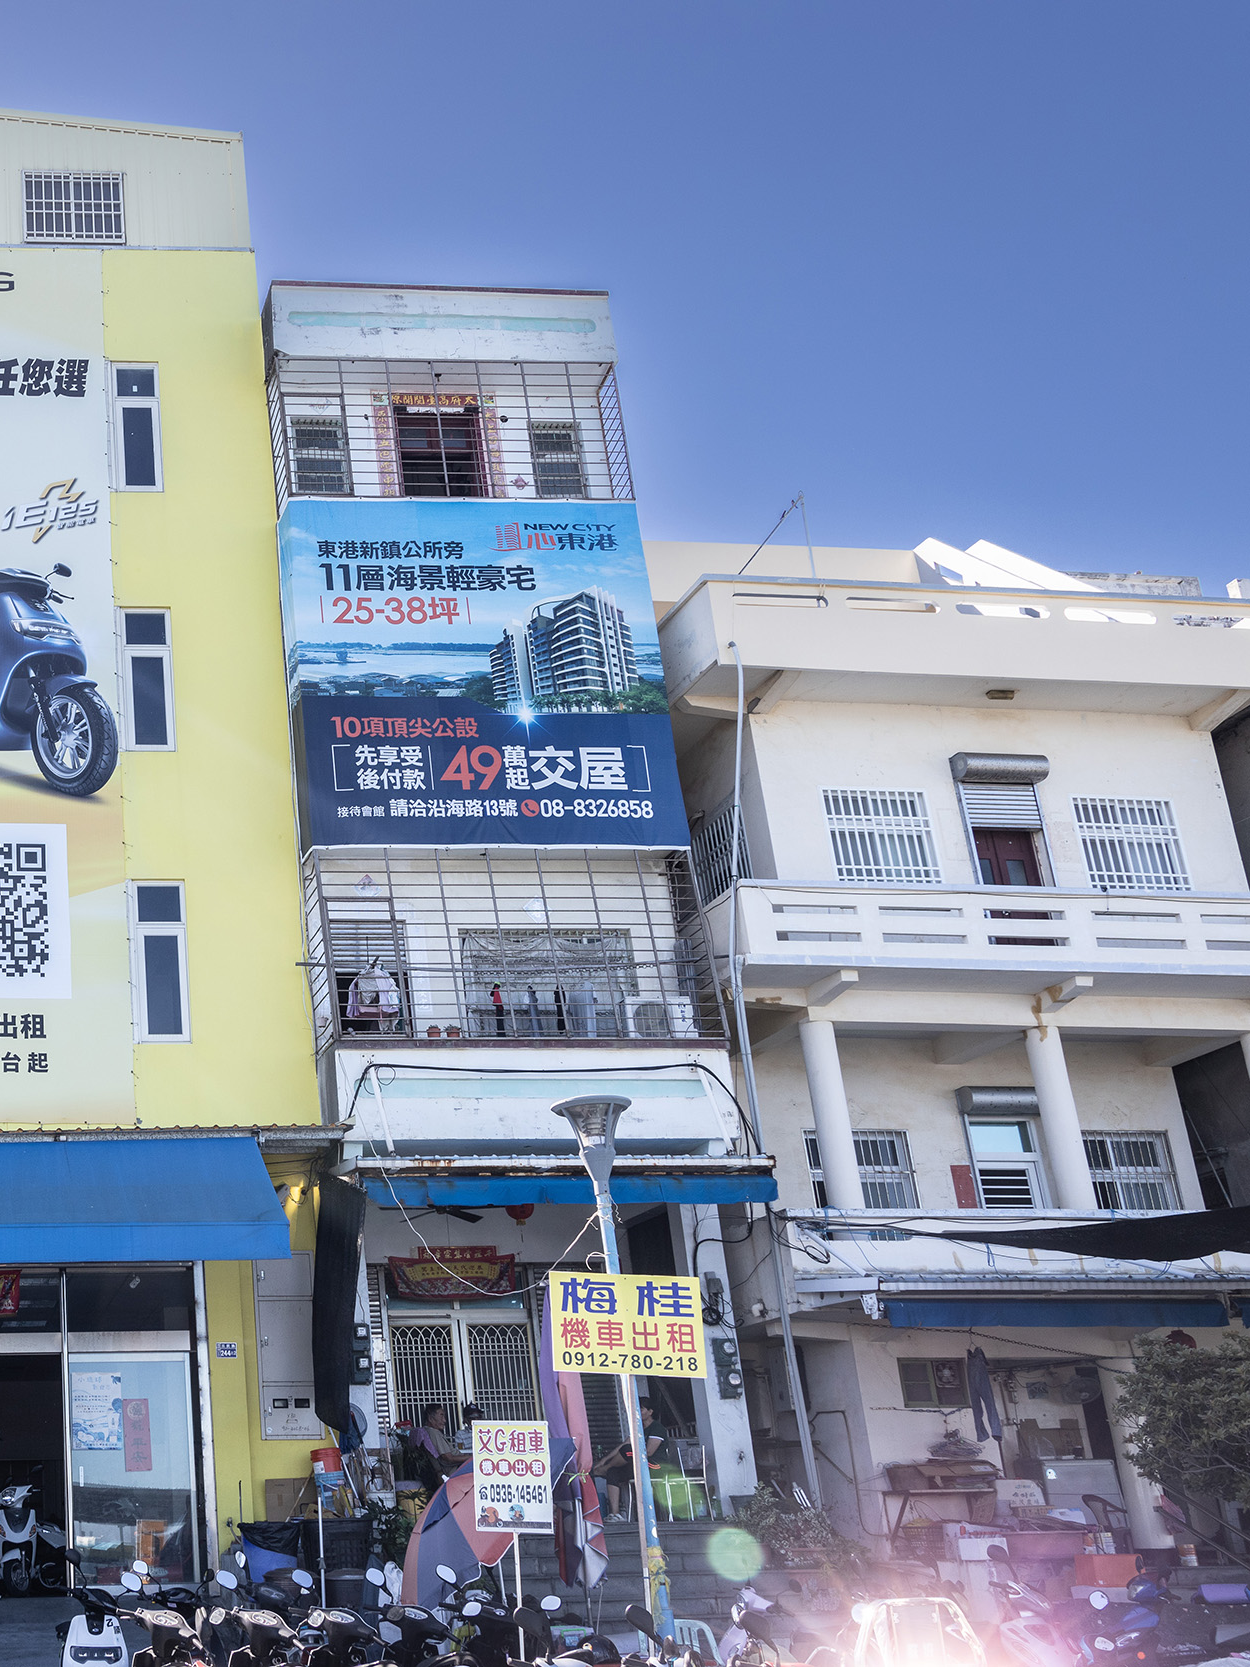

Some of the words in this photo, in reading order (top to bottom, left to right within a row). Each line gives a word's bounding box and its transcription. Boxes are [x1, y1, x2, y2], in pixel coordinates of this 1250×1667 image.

[524, 523, 569, 531] NEW
[317, 540, 464, 560] 東港新鎮公所旁
[319, 563, 537, 592] 11層海景輕豪宅
[332, 596, 460, 625] 25-38坪
[330, 716, 480, 739] 10項頂尖公設
[355, 744, 424, 767] 先享受
[356, 768, 426, 791] 後付款
[337, 806, 385, 818] 接待會館
[389, 799, 518, 818] 請洽沿海路13號
[540, 799, 654, 819] 08-8326858
[560, 1317, 697, 1353] 機車出租
[562, 1351, 698, 1371] 0912-780-218
[478, 1428, 545, 1453] 艾G租車
[481, 1460, 544, 1475] 機車出租
